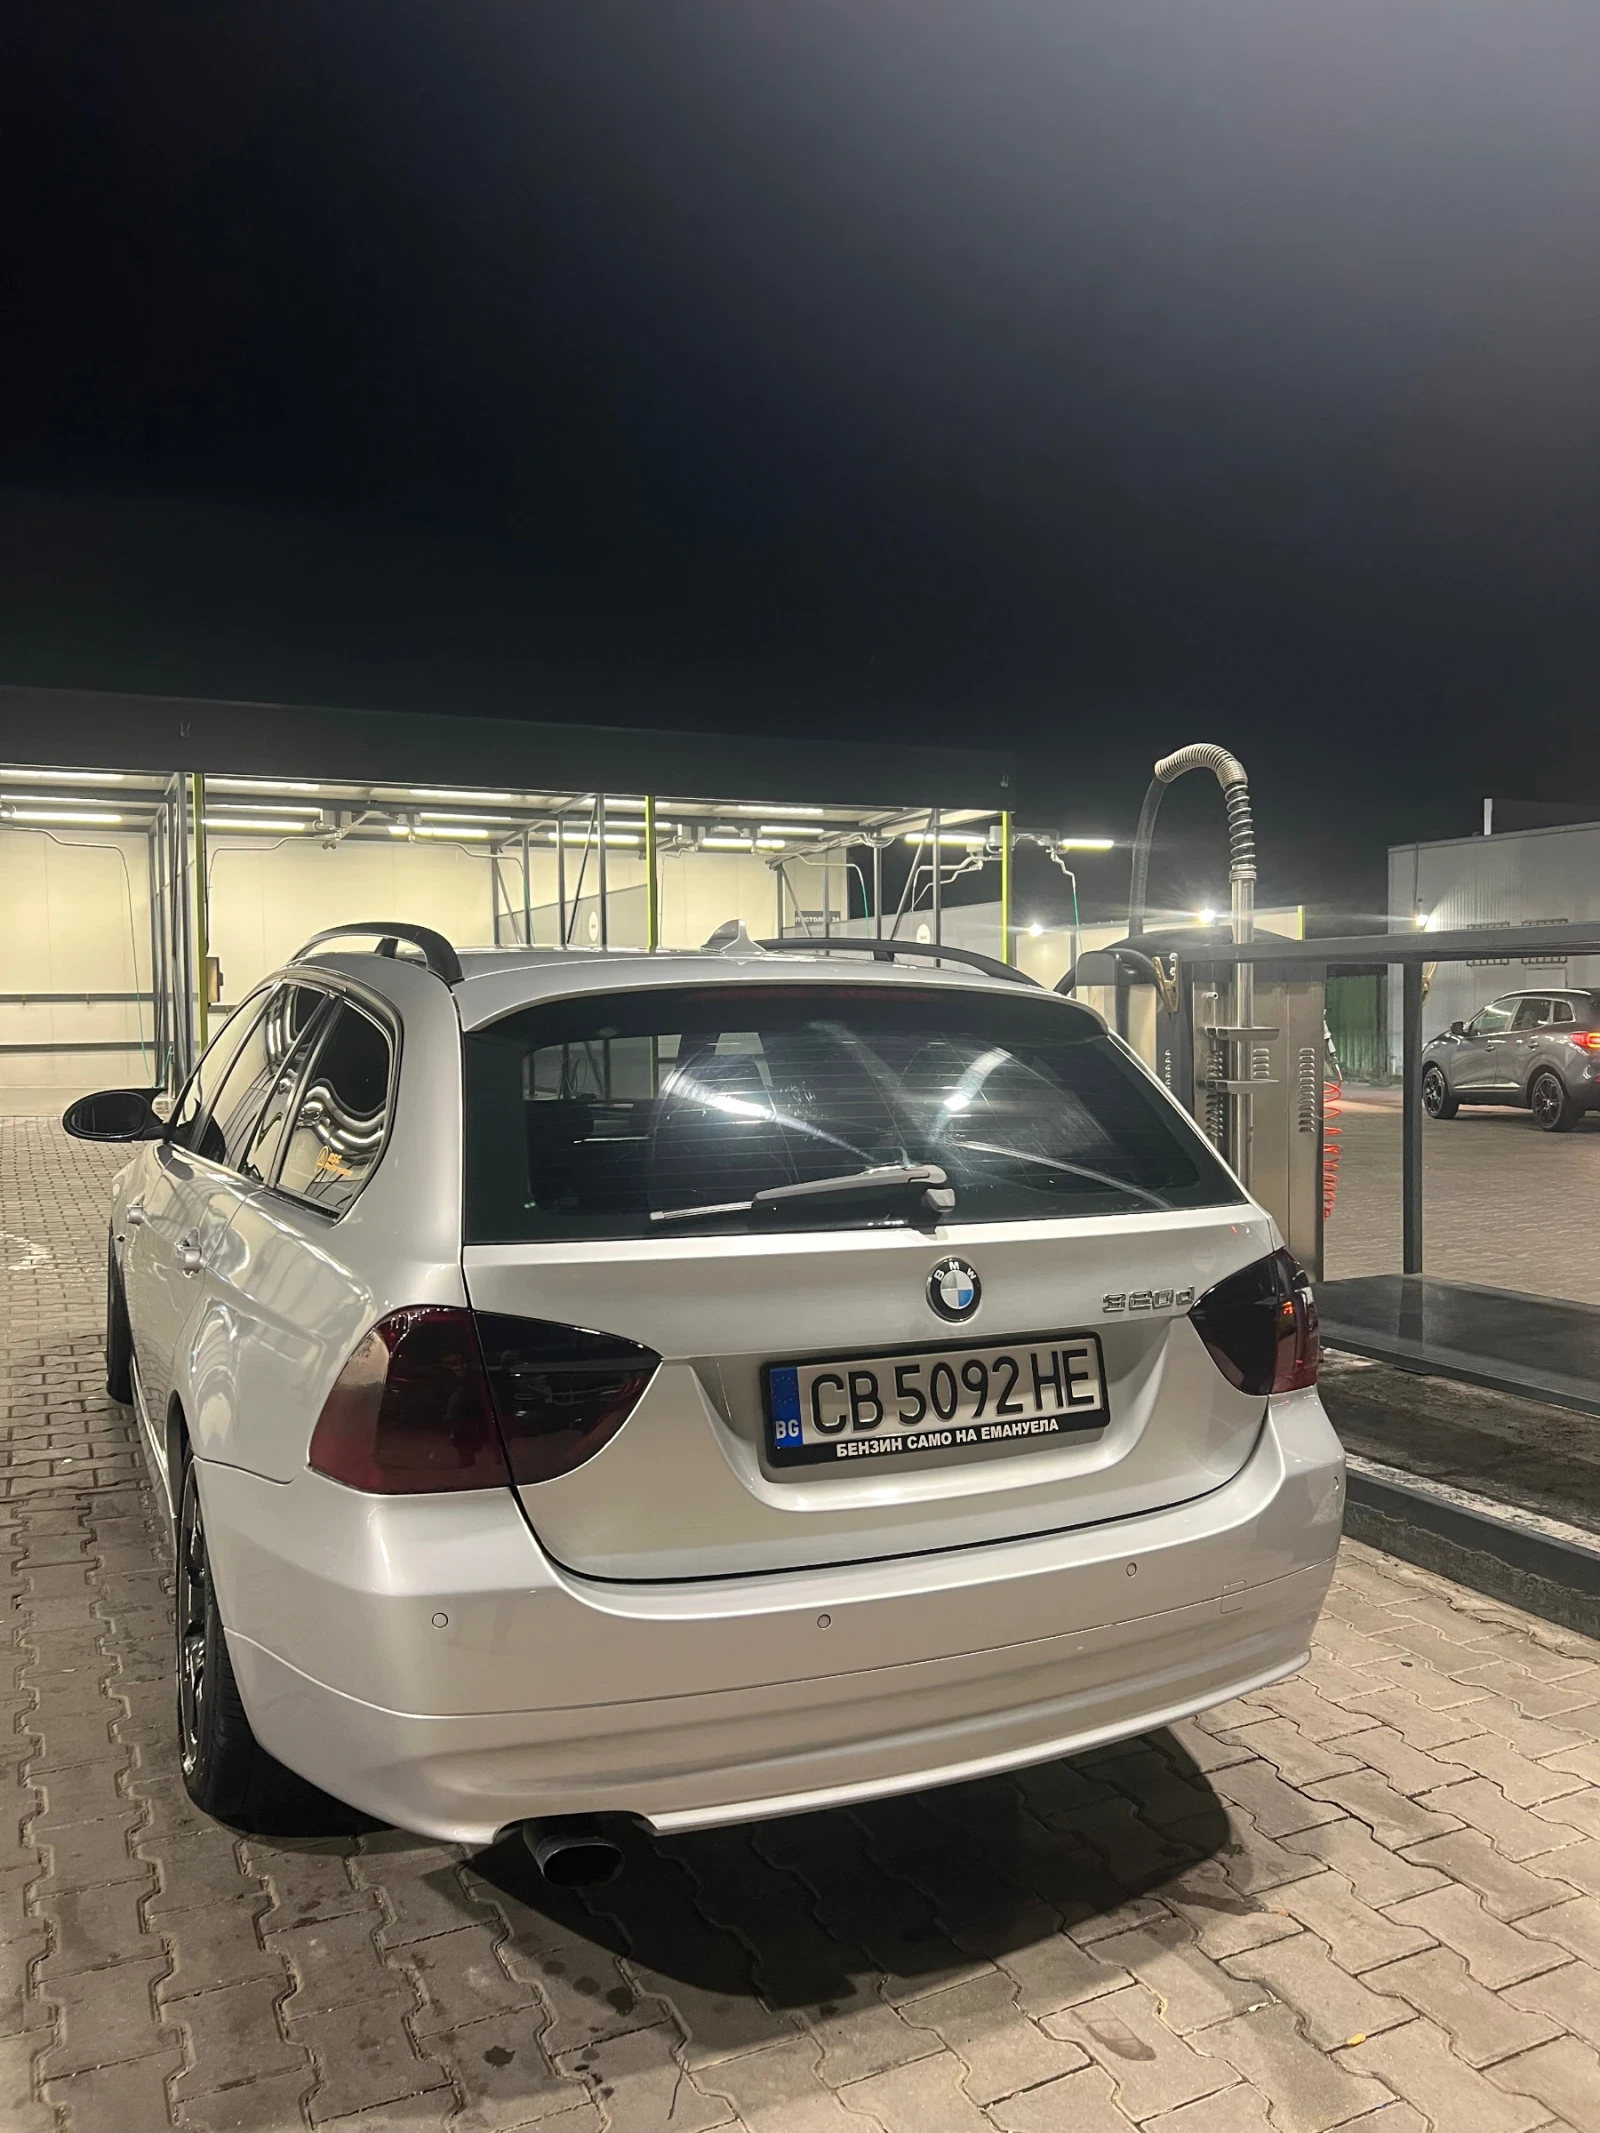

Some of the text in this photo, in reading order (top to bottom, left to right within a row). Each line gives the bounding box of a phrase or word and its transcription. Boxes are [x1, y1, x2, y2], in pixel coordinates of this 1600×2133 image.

[934, 1261, 976, 1281] BMW
[1102, 1285, 1195, 1313] 320d
[894, 1356, 1024, 1426] 5092
[775, 1419, 799, 1439] BG
[836, 1418, 1059, 1457] БЕНЗИН САМО НА ЕМАНУЕЛА
